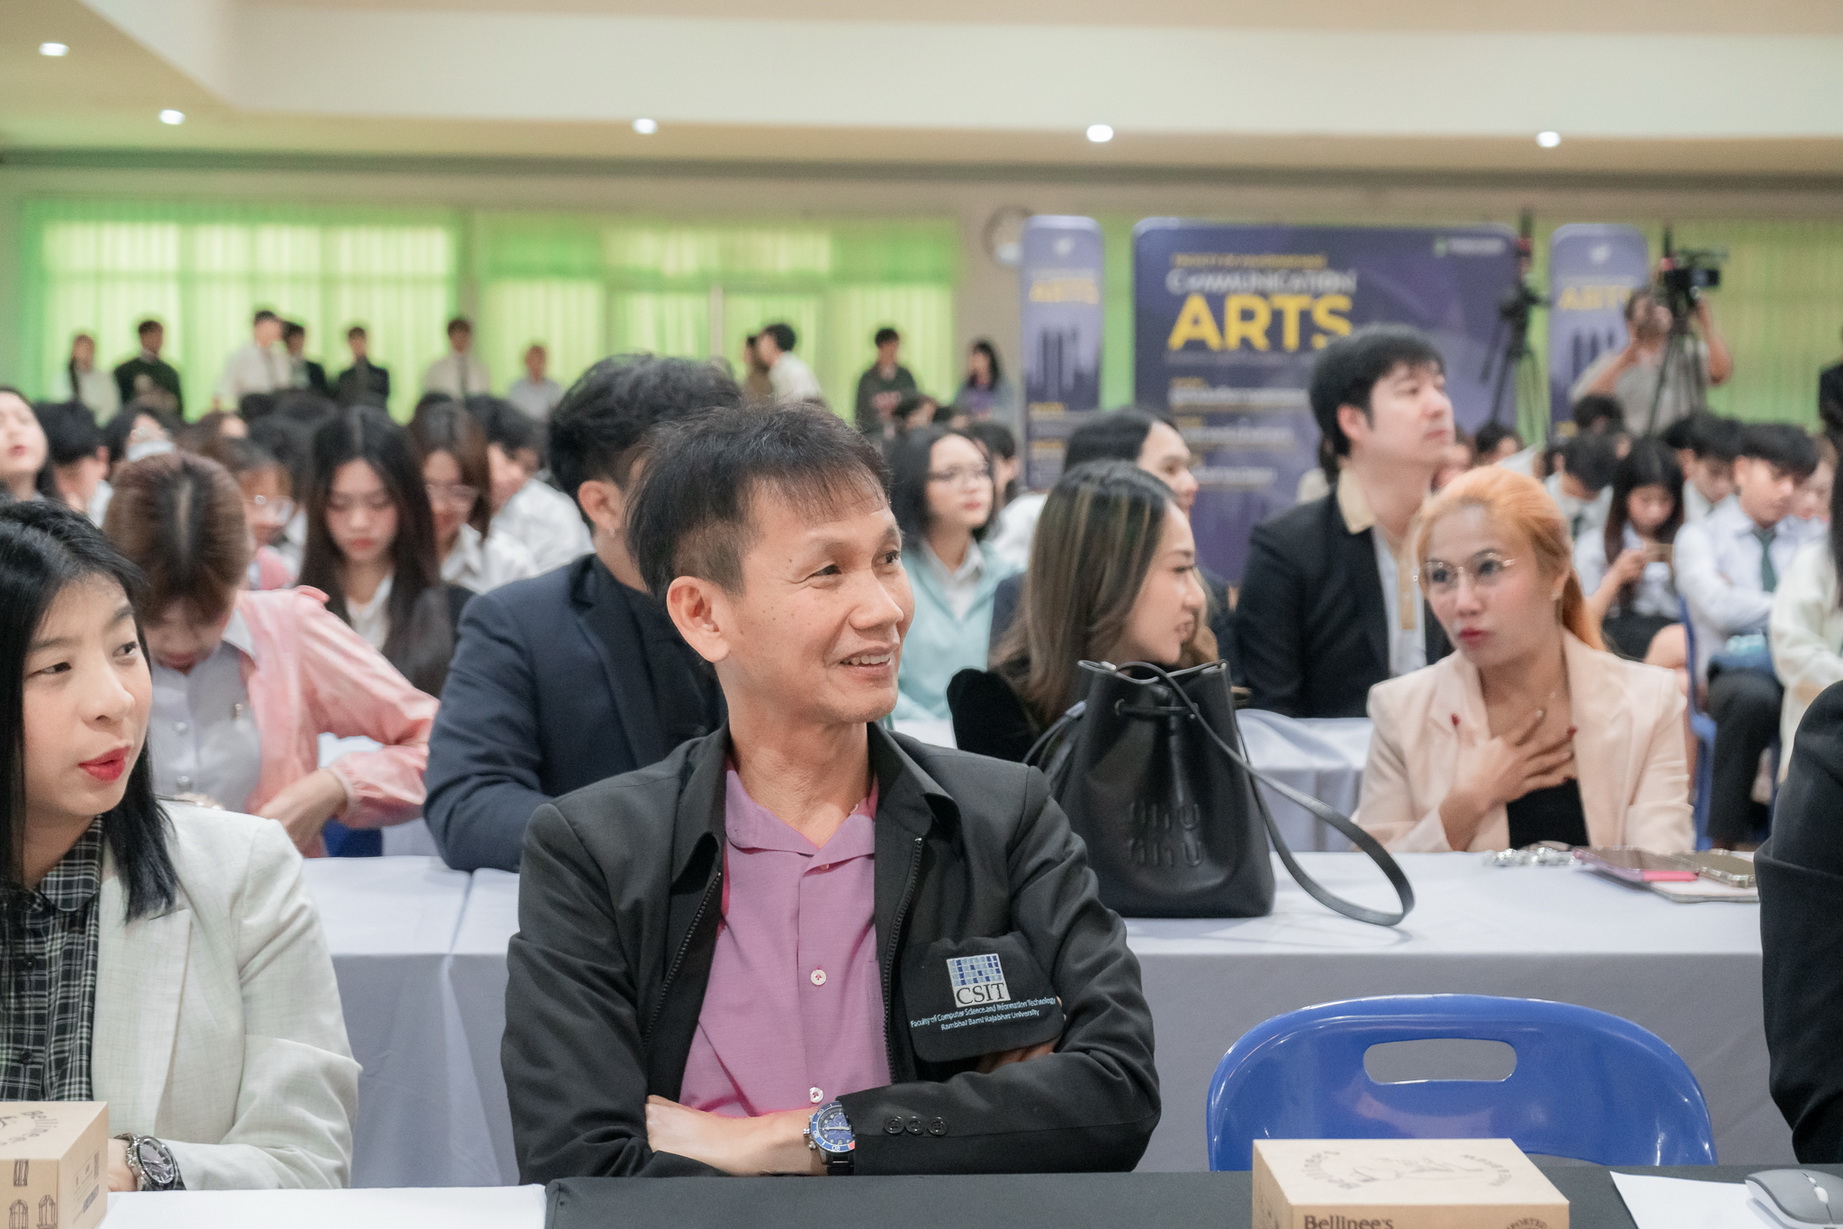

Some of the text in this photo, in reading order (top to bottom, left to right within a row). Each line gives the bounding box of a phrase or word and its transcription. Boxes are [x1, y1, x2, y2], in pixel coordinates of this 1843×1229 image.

[1168, 294, 1353, 351] ARTS
[956, 982, 1005, 1005] CSIT
[911, 997, 1056, 1028] Faculty of Computer Science and Information Technology
[1011, 1009, 1039, 1019] University
[1303, 1214, 1395, 1229] Bellinee's
